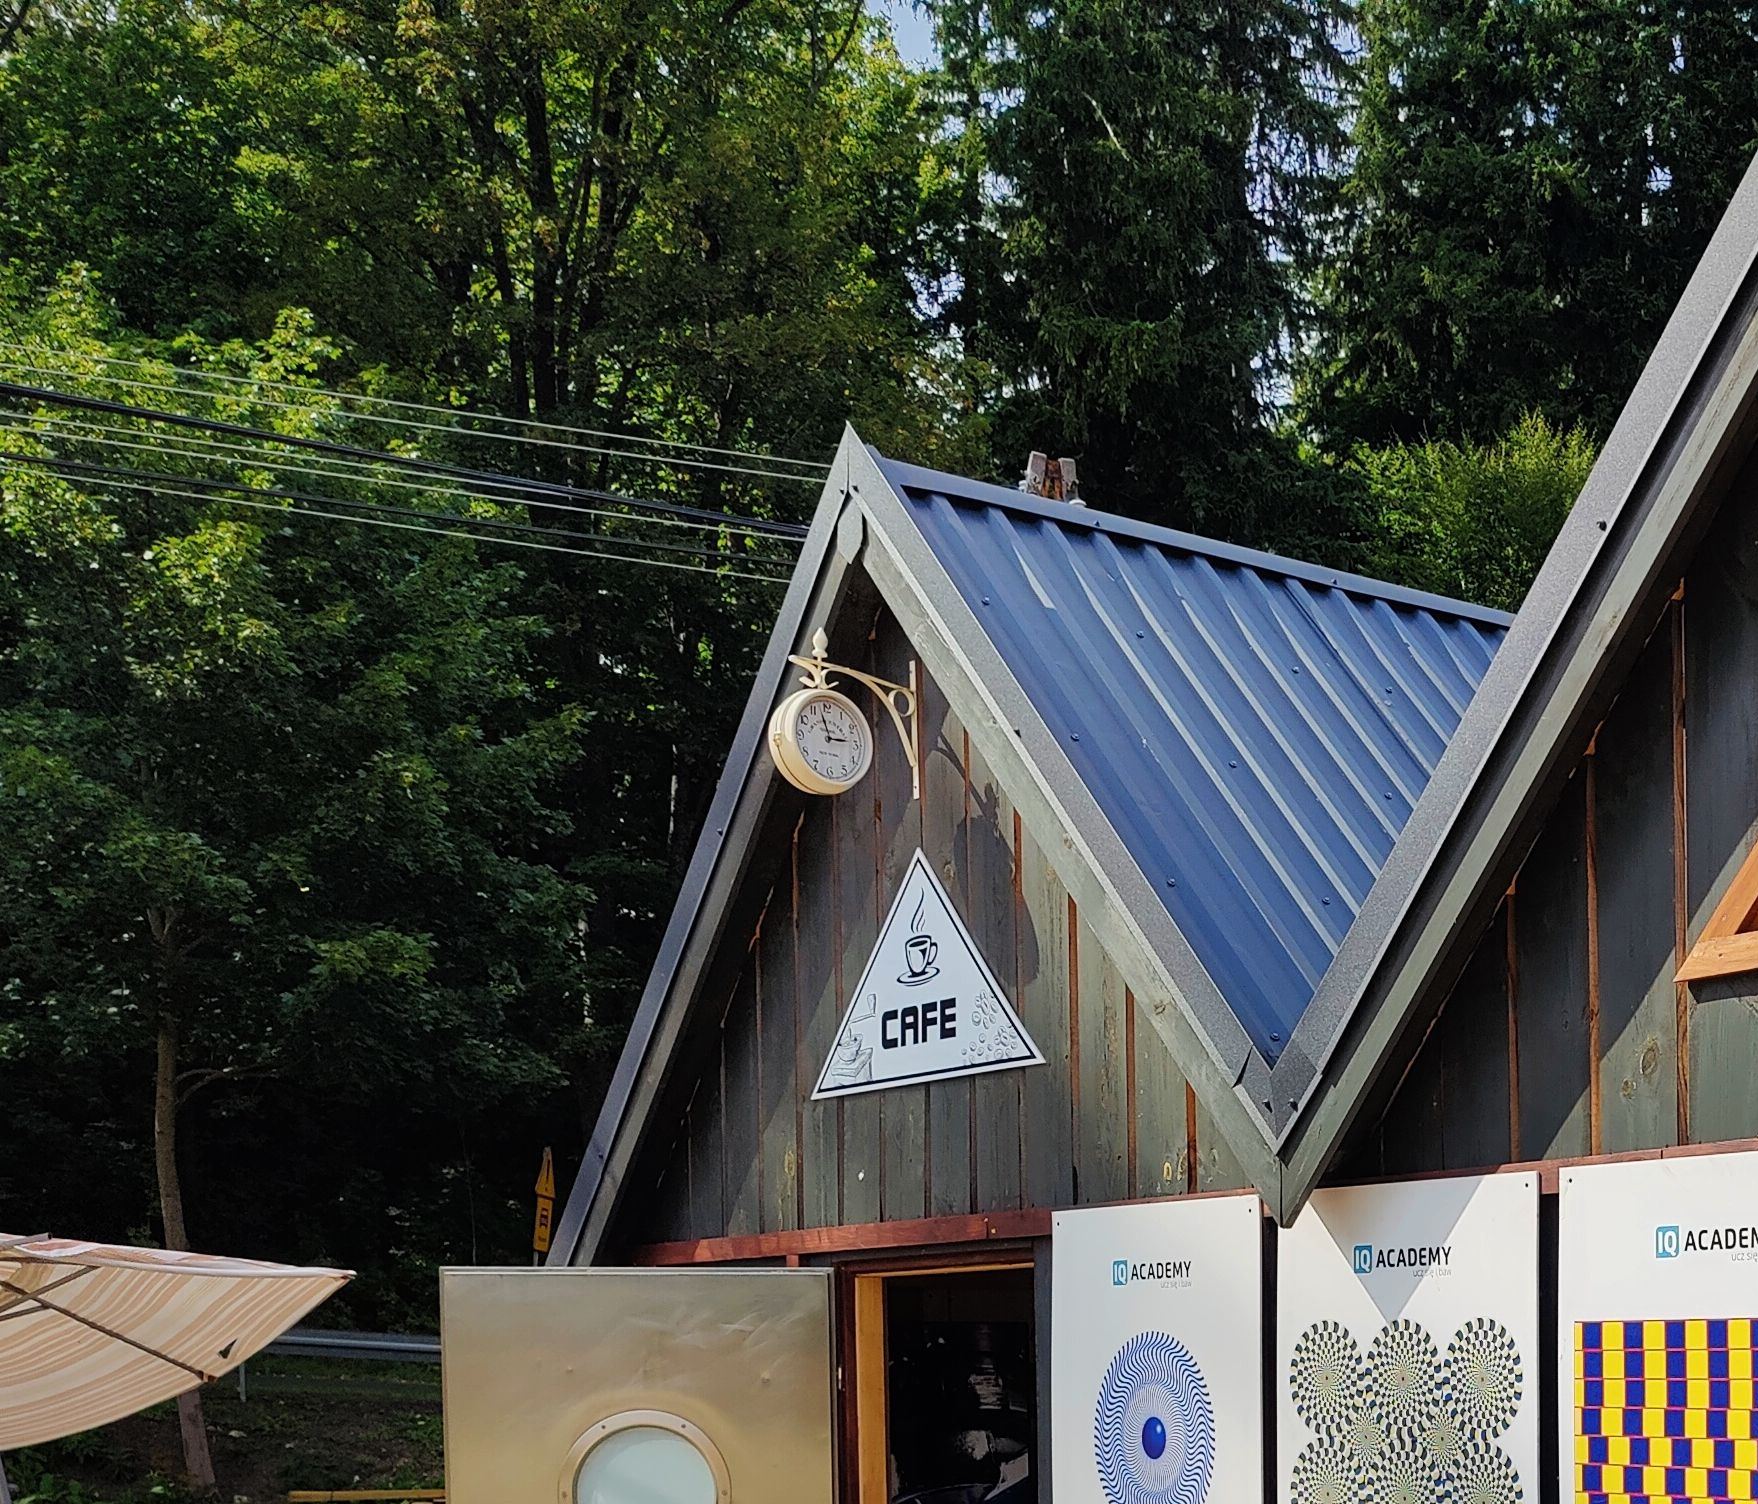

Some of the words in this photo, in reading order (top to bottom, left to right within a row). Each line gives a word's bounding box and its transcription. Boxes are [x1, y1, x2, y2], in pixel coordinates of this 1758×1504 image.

[881, 997, 956, 1050] CAFE
[1657, 1230, 1678, 1257] IQ
[1732, 1253, 1744, 1261] ucz
[1114, 1263, 1126, 1284] IQ
[1130, 1260, 1191, 1280] ACADEMY
[1355, 1249, 1371, 1273] IQ
[1376, 1246, 1451, 1268] ACADEMY
